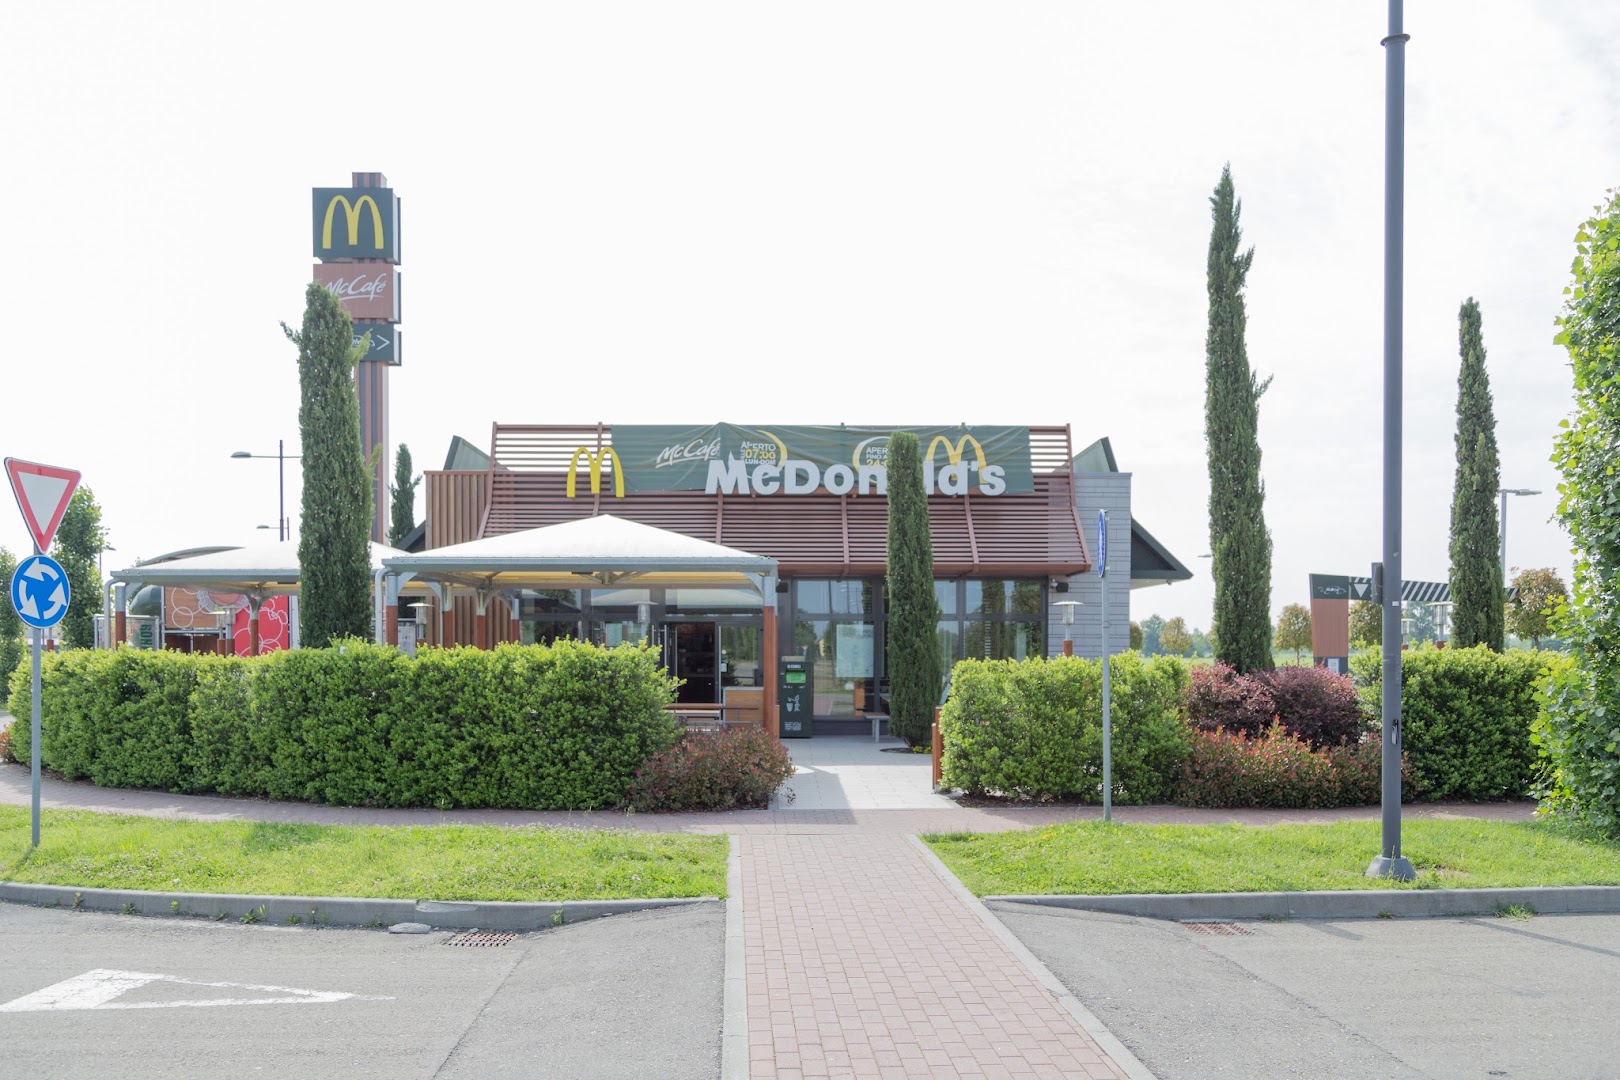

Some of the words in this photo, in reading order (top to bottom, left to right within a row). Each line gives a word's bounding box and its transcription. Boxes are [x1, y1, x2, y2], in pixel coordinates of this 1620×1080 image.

[740, 440, 777, 452] APERTO
[866, 446, 889, 455] APER
[704, 459, 1007, 496] McDonld's
